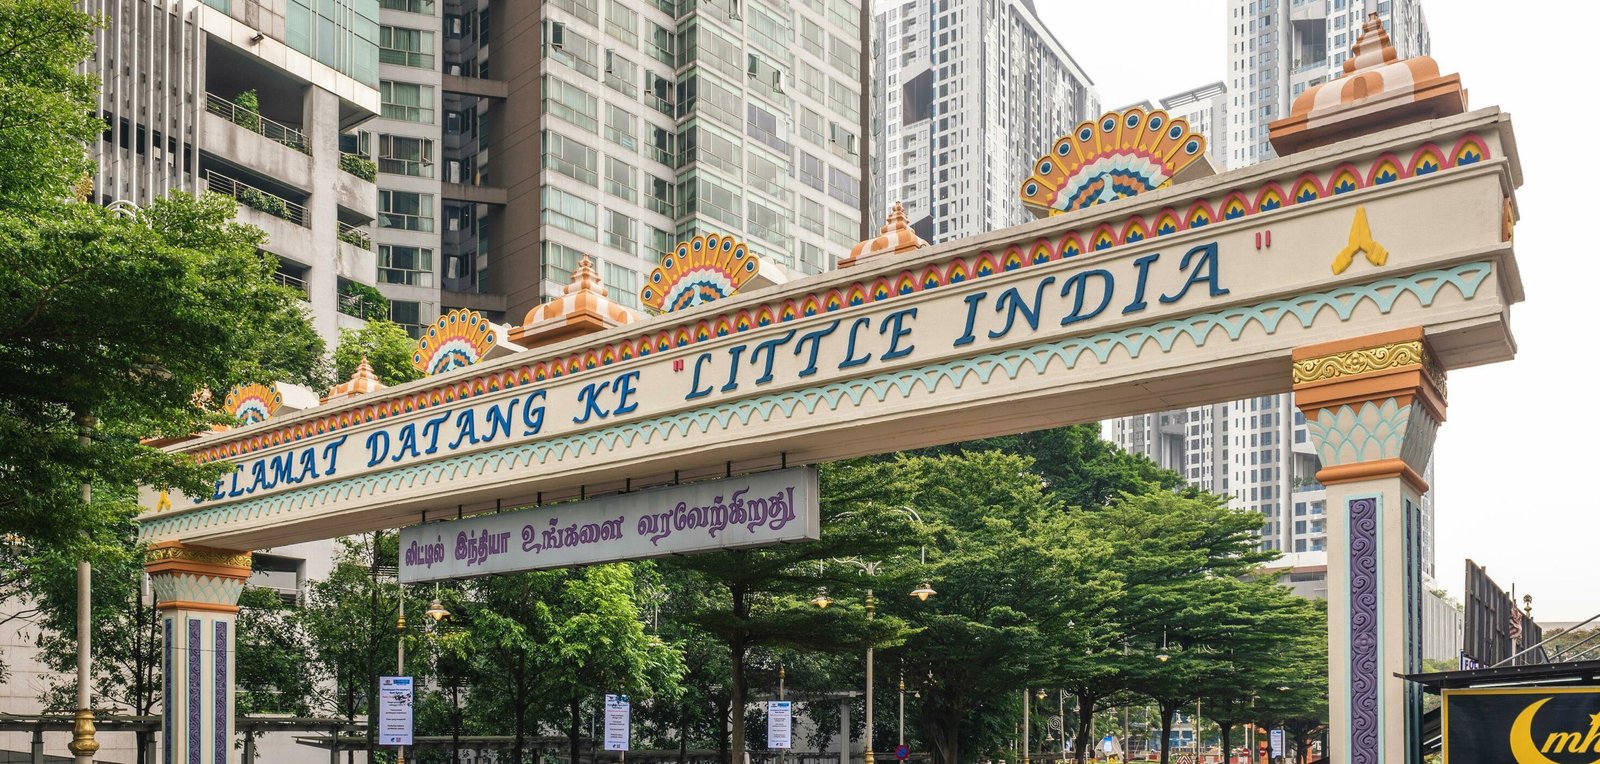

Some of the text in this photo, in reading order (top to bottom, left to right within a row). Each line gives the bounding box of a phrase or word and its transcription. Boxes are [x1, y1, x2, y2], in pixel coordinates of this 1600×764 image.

[193, 435, 349, 504] ELAMAT
[365, 390, 547, 468] DATANG
[572, 370, 640, 424] KE
[455, 529, 511, 567] இந்தியா
[637, 485, 796, 546] வரவேற்கிறது
